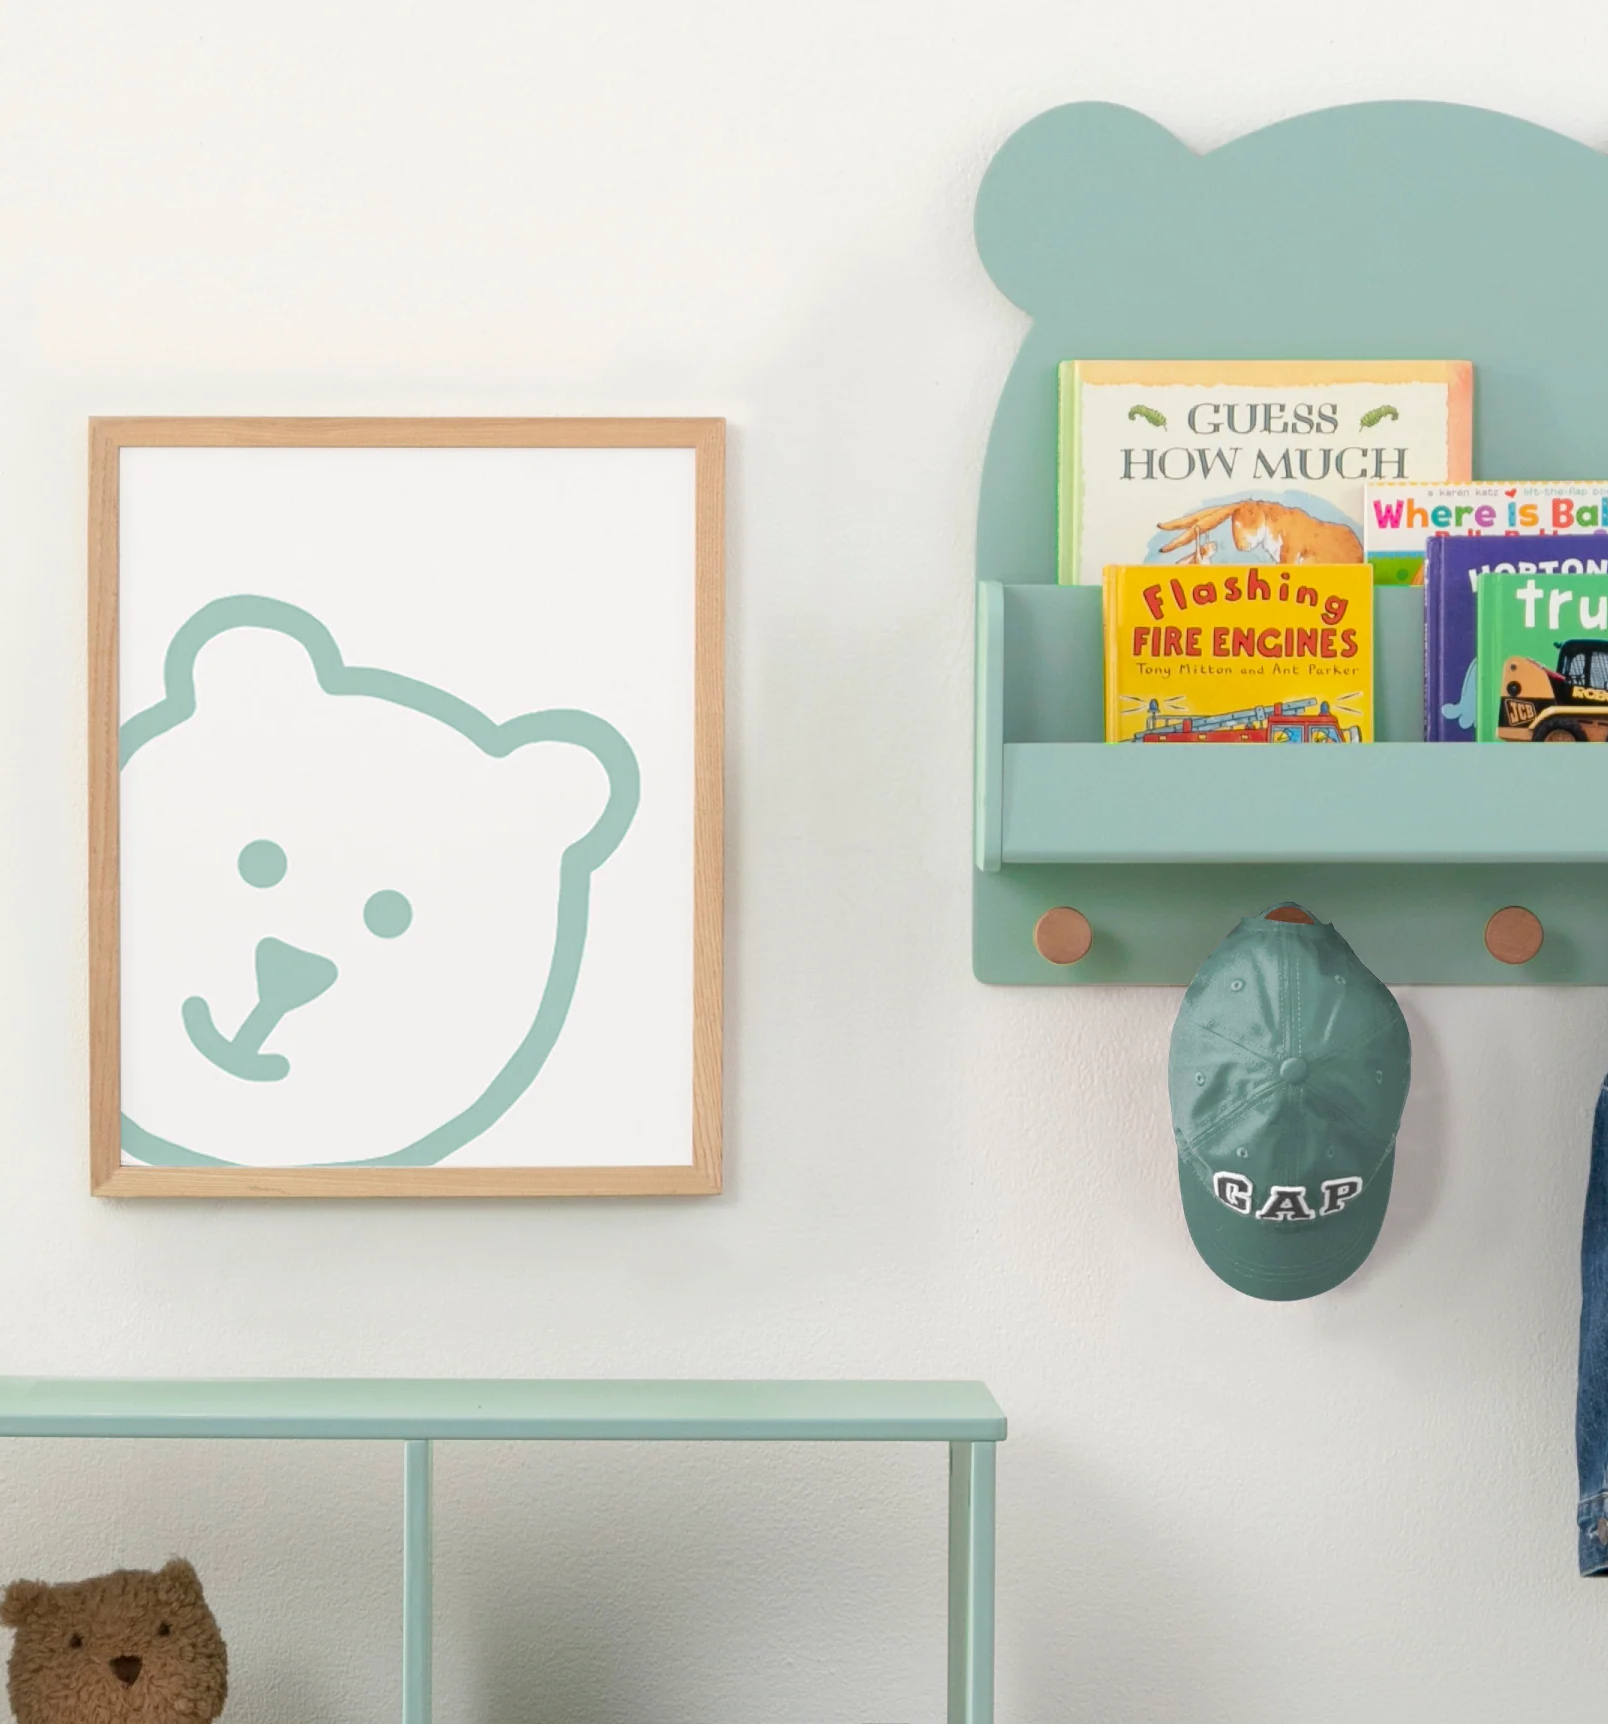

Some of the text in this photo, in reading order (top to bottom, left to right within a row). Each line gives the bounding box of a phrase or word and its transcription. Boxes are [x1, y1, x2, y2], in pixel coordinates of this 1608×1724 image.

[1188, 403, 1338, 434] GUESS
[1120, 447, 1409, 481] HOW MUCH
[1373, 498, 1497, 529] Where
[1143, 567, 1349, 626] Flashing
[1132, 626, 1359, 658] FIRE ENGINES
[1136, 662, 1360, 680] Tony Mitton and Ant Parker
[1509, 700, 1534, 724] JCB
[1212, 1171, 1363, 1221] GAP
